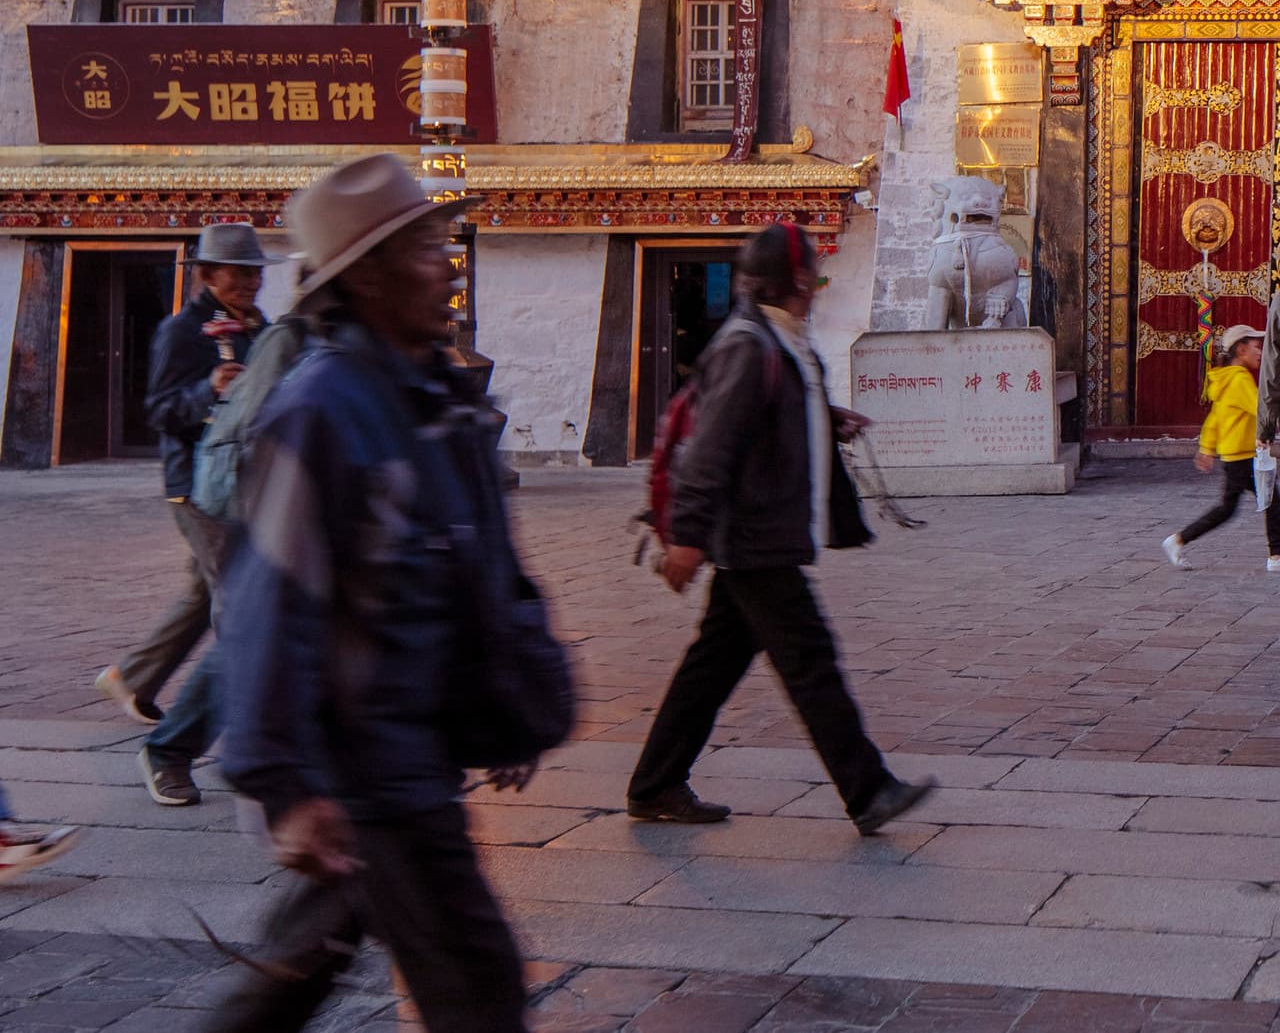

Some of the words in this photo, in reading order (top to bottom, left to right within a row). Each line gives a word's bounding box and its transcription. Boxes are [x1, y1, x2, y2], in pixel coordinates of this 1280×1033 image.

[153, 80, 376, 121] 大昭福饼
[964, 369, 1043, 394] 冲赛康
